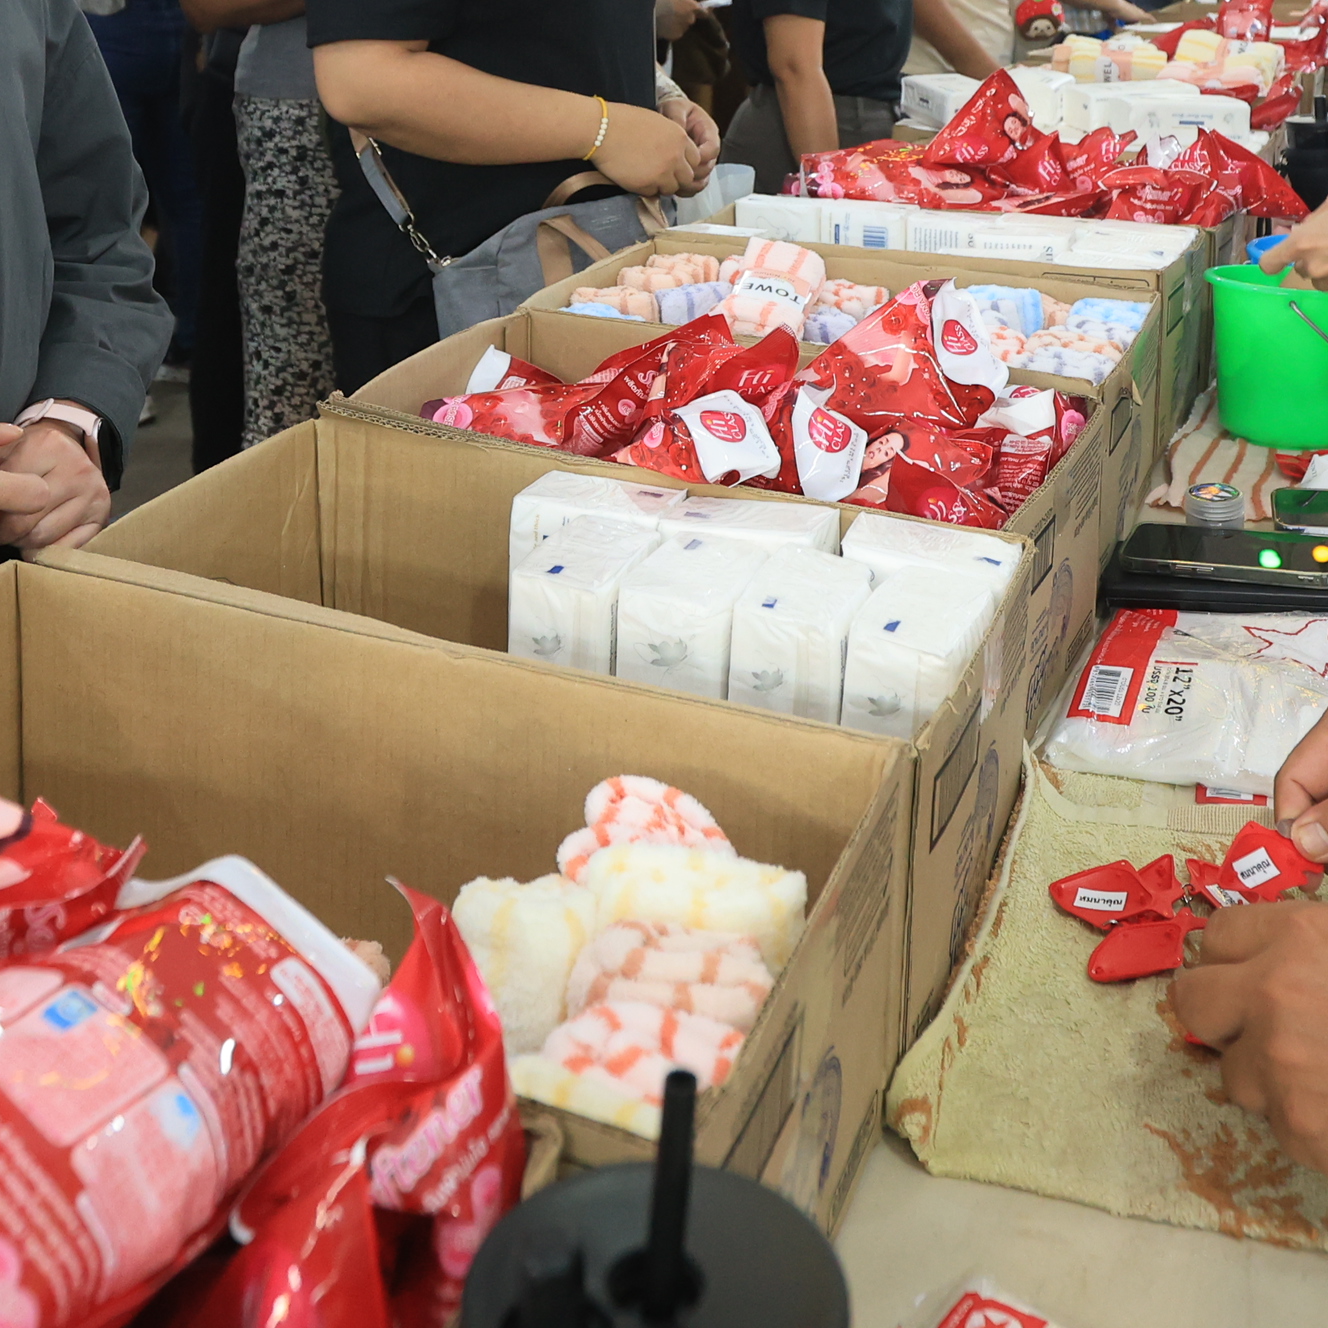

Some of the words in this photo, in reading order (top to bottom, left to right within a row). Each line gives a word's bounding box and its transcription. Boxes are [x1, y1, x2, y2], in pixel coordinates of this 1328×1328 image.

[735, 281, 801, 306] TOWE
[738, 369, 775, 387] Hi
[721, 411, 743, 440] CLAS
[831, 420, 847, 451] CLAS
[1144, 687, 1157, 703] 100
